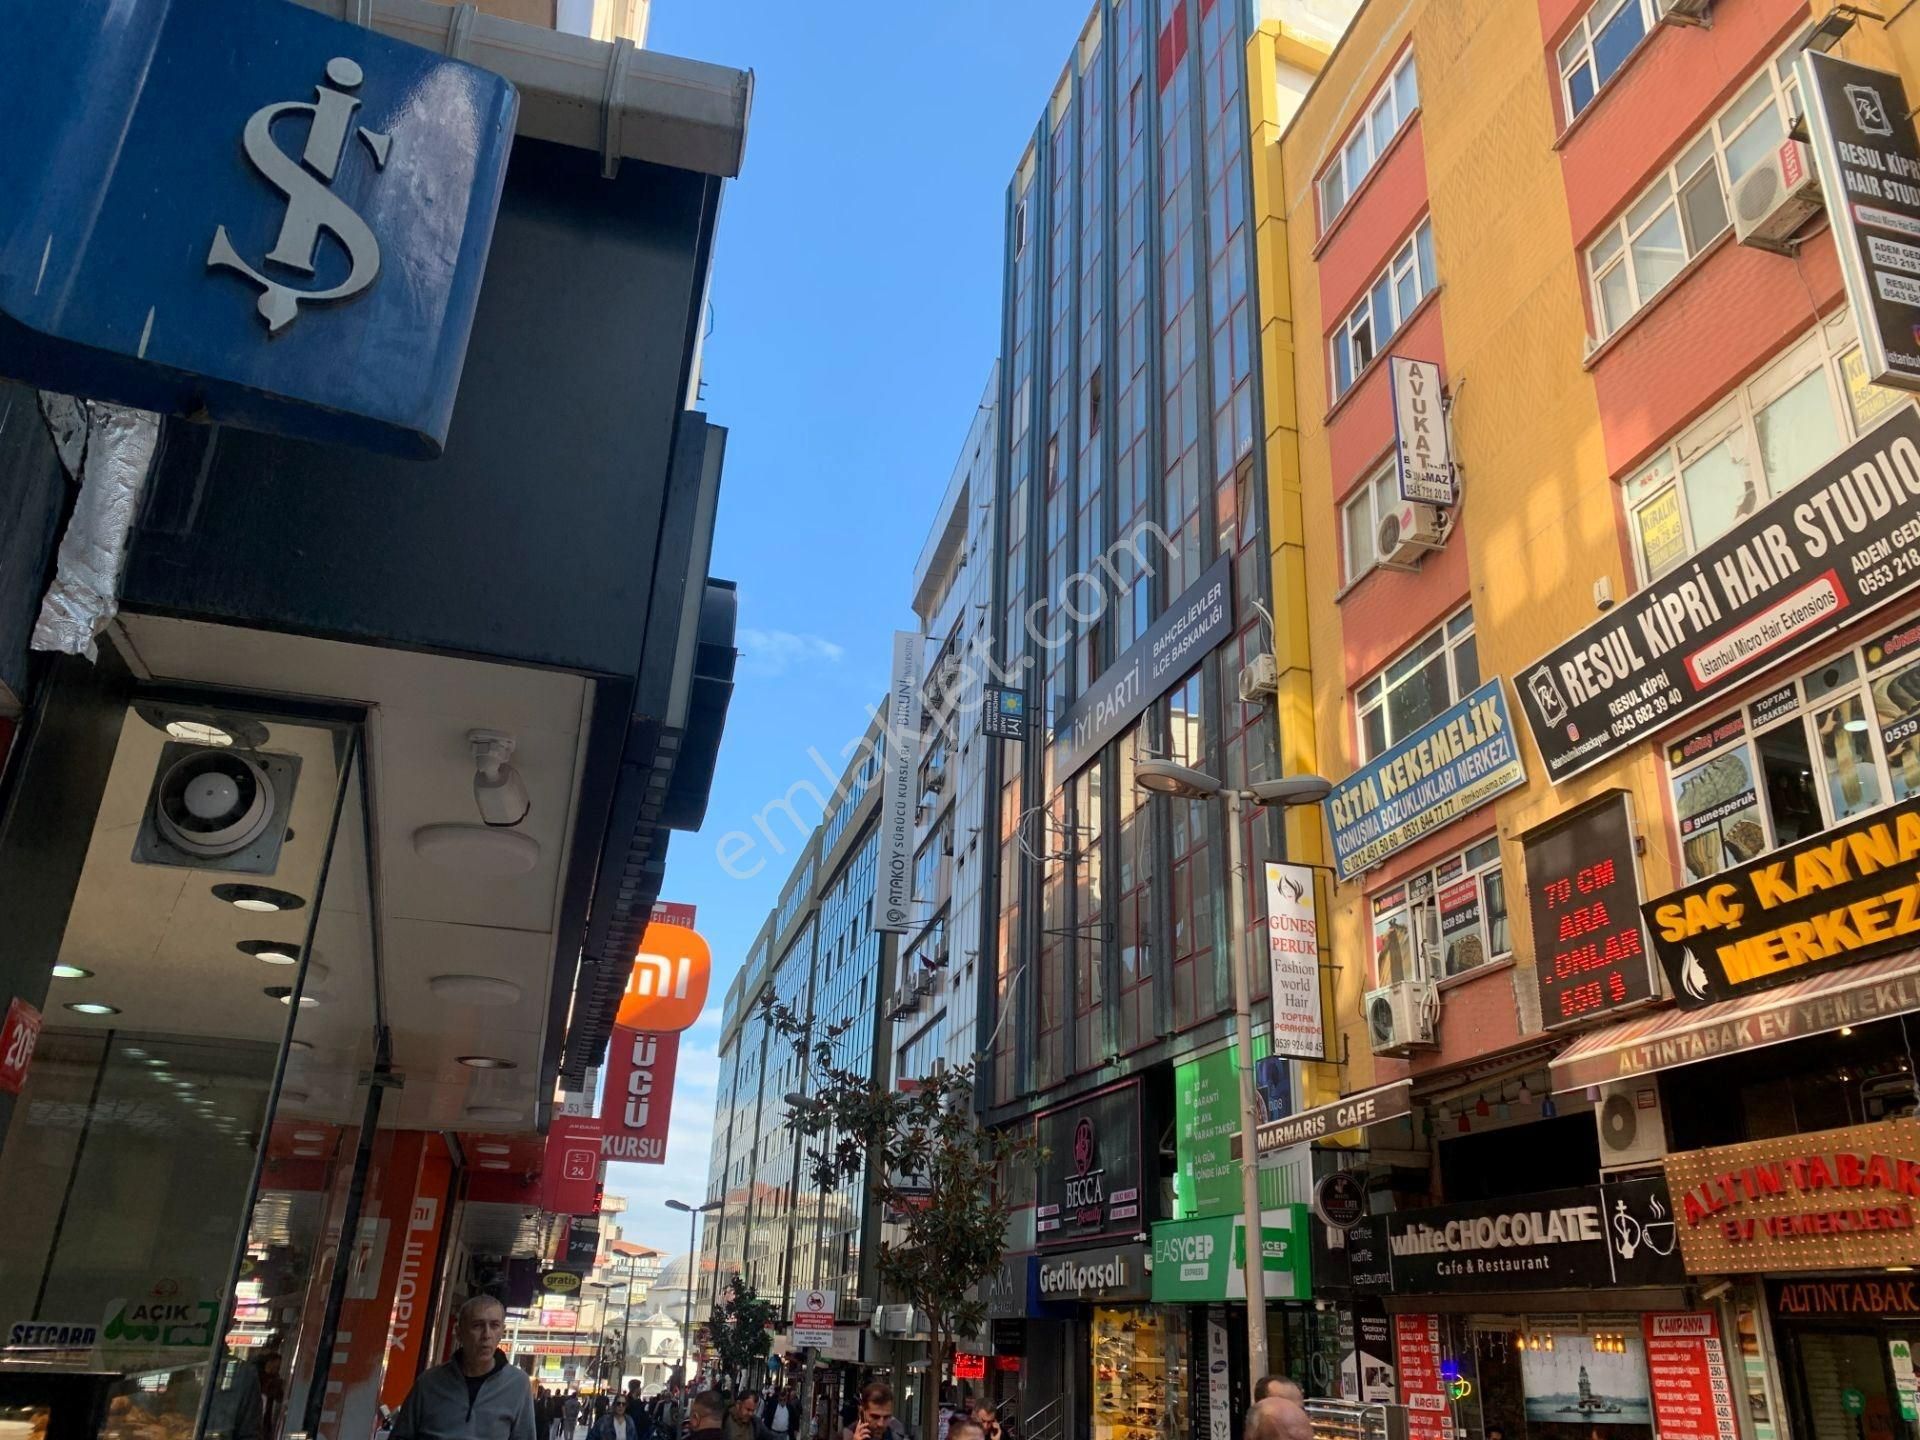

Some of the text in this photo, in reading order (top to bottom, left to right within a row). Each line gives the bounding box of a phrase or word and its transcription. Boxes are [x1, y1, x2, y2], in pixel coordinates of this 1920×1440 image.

[1838, 141, 1886, 171] RESUL
[1845, 169, 1882, 198] HAIR
[1874, 242, 1901, 256] ADEM
[1875, 252, 1917, 270] 0553 218
[1885, 277, 1916, 292] RESUL
[1408, 363, 1430, 470] AVUKAT
[1850, 511, 1920, 575] ADEM GED
[1559, 436, 1920, 708] RESUL KİPRİ HAIR STUDIO
[1858, 548, 1920, 596] 0553 218
[1152, 581, 1222, 659] BAHÇELİEVLER
[1699, 589, 1838, 679] İstanbul Micro Hair Extensions
[1151, 604, 1223, 681] İLÇE BAŞKANLIĞI
[1074, 658, 1140, 753] İYİ PARTİ
[1608, 667, 1671, 718] RESUL KİPRİ
[1756, 688, 1792, 713] TOPTAN
[1007, 717, 1022, 736] İYİ
[1611, 687, 1683, 738] 0543 682 39 40
[1752, 698, 1800, 728] PERAKENDE
[1883, 720, 1919, 744] 0539
[1330, 697, 1504, 832] RİTM KEKEMELİK
[1336, 730, 1512, 857] KONUŞMA BOZUKLUKLARI MERKEZİ
[1693, 790, 1756, 829] gunesperuk
[888, 744, 910, 907] ATAKÖY SÜRÜCÜ KURSLARI
[1350, 852, 1368, 871] 0212
[1402, 822, 1420, 840] 0531
[1576, 858, 1616, 895] CM
[1269, 913, 1317, 938] GÜNEŞ
[1559, 901, 1612, 943] ARA
[1655, 884, 1745, 944] SAÇ
[1716, 871, 1920, 986] MERKEZ
[1272, 937, 1317, 956] PERUK
[1274, 958, 1316, 977] Fashion
[1280, 977, 1311, 993] world
[1285, 992, 1309, 1010] Hair
[1274, 1022, 1322, 1036] PERAKENDE
[1281, 1012, 1315, 1025] TOPTAN
[1275, 1037, 1291, 1051] 0539
[1292, 1038, 1305, 1051] 926
[1618, 1017, 1755, 1076] ALTINTABAK
[1757, 1008, 1792, 1040] EV
[568, 1103, 580, 1114] 53
[1257, 1098, 1377, 1151] MARMARiS CAFE
[600, 1134, 664, 1159] KURSU
[571, 1166, 585, 1177] 24
[1066, 1173, 1104, 1209] BECCA
[1681, 1151, 1920, 1226] ALTINTABAK
[1349, 1226, 1373, 1241] coffee
[1720, 1217, 1756, 1242] EV
[1155, 1234, 1214, 1264] EASYCEP
[1261, 1240, 1288, 1251] YCEP
[1351, 1248, 1373, 1262] waffle
[1039, 1254, 1126, 1297] Gedikpaşalı
[1352, 1271, 1391, 1285] restaurant
[1437, 1254, 1551, 1276] Cafe & Restaurant
[546, 1275, 577, 1286] gratis
[1779, 1280, 1920, 1314] ALTINTABAK
[131, 1302, 192, 1322] AÇIK
[1657, 1317, 1705, 1334] KAMPANYA
[1362, 1324, 1387, 1335] Galaxy
[1364, 1333, 1387, 1342] Watch
